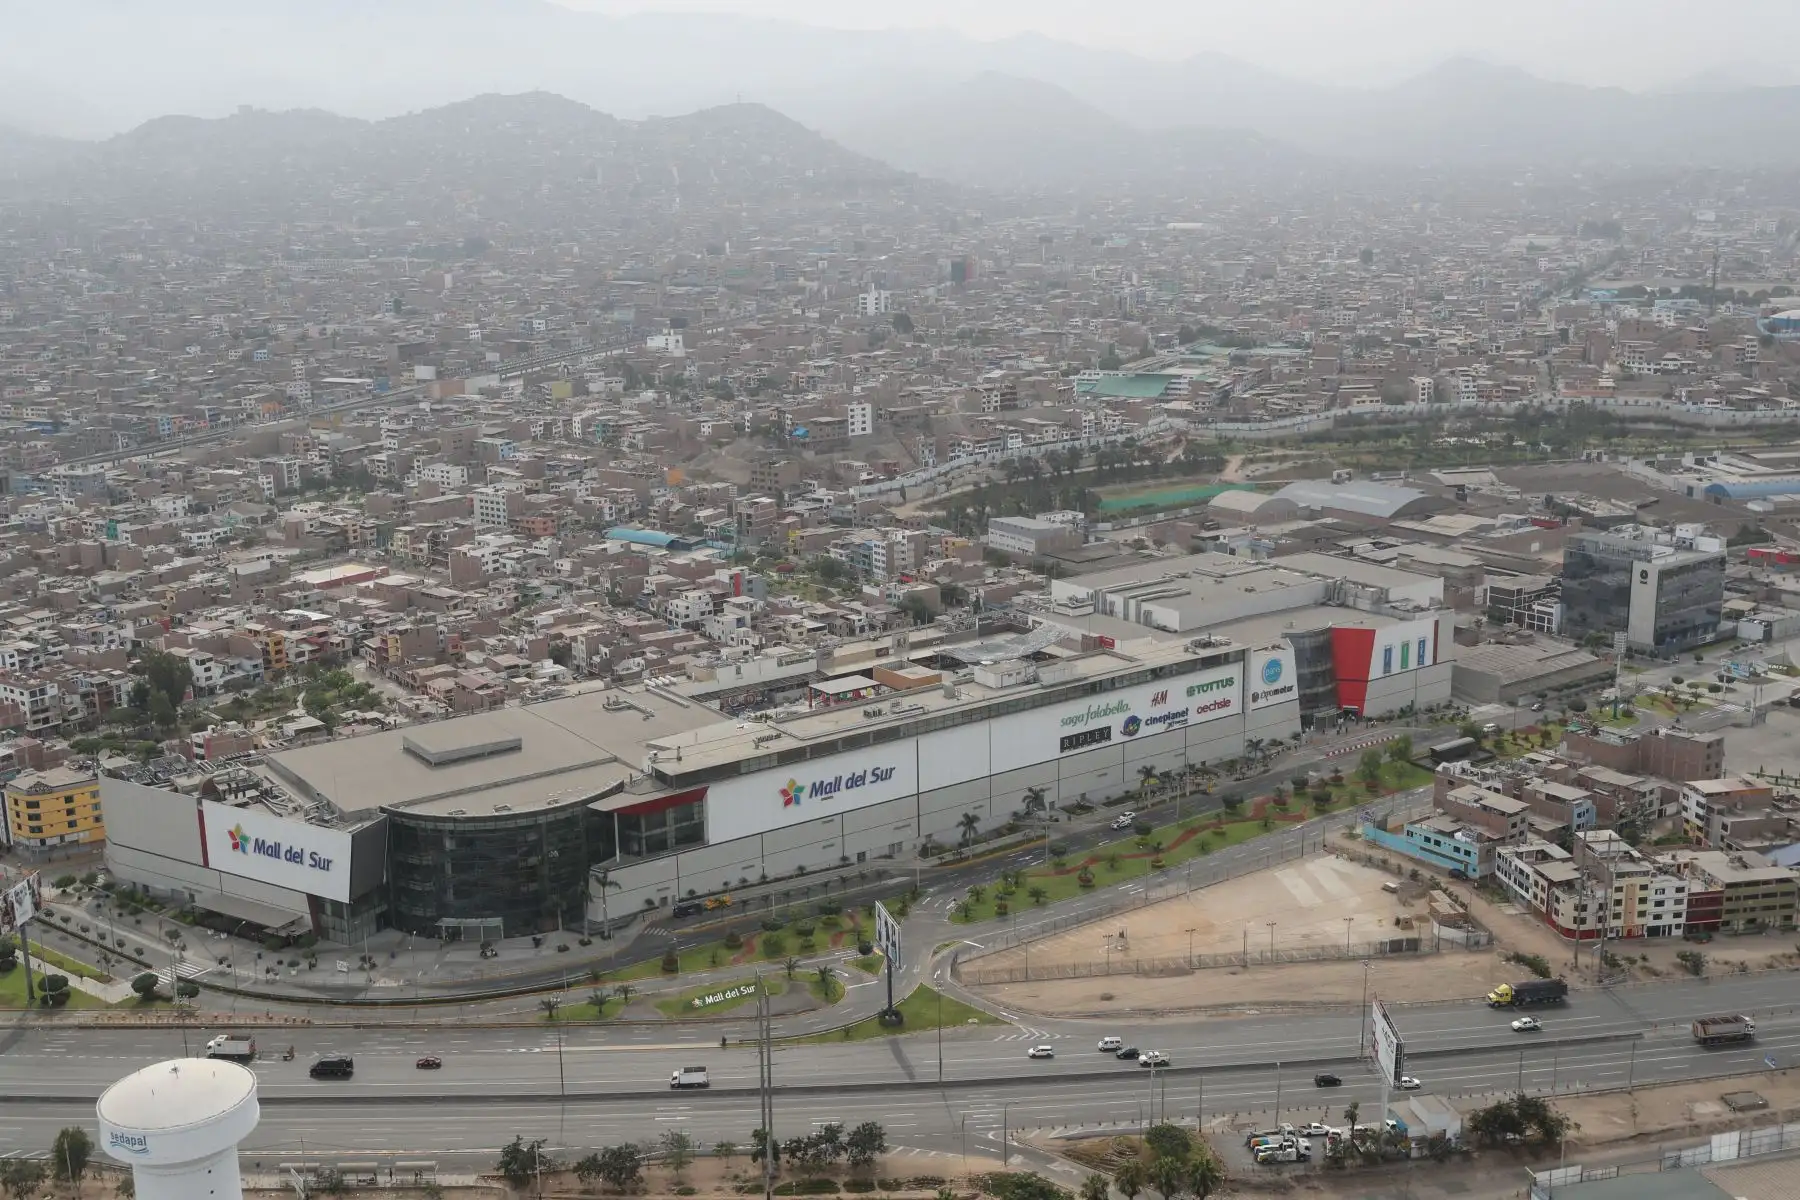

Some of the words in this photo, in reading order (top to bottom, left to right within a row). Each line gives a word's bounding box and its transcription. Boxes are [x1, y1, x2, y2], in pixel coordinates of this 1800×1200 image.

[1195, 676, 1235, 695] TOTTUS
[1196, 698, 1232, 714] oechsle
[1060, 713, 1084, 727] saga
[1145, 707, 1189, 726] cineplanet
[1063, 728, 1109, 748] RIPLEY
[808, 775, 843, 799] Mall
[845, 771, 867, 790] del
[869, 766, 896, 784] Sur
[253, 837, 281, 860] Mall
[284, 845, 304, 865] del
[308, 851, 333, 872] Sur
[704, 992, 724, 1005] Mall
[725, 988, 740, 999] del
[740, 984, 756, 995] Sur
[110, 1131, 147, 1148] sedapal
